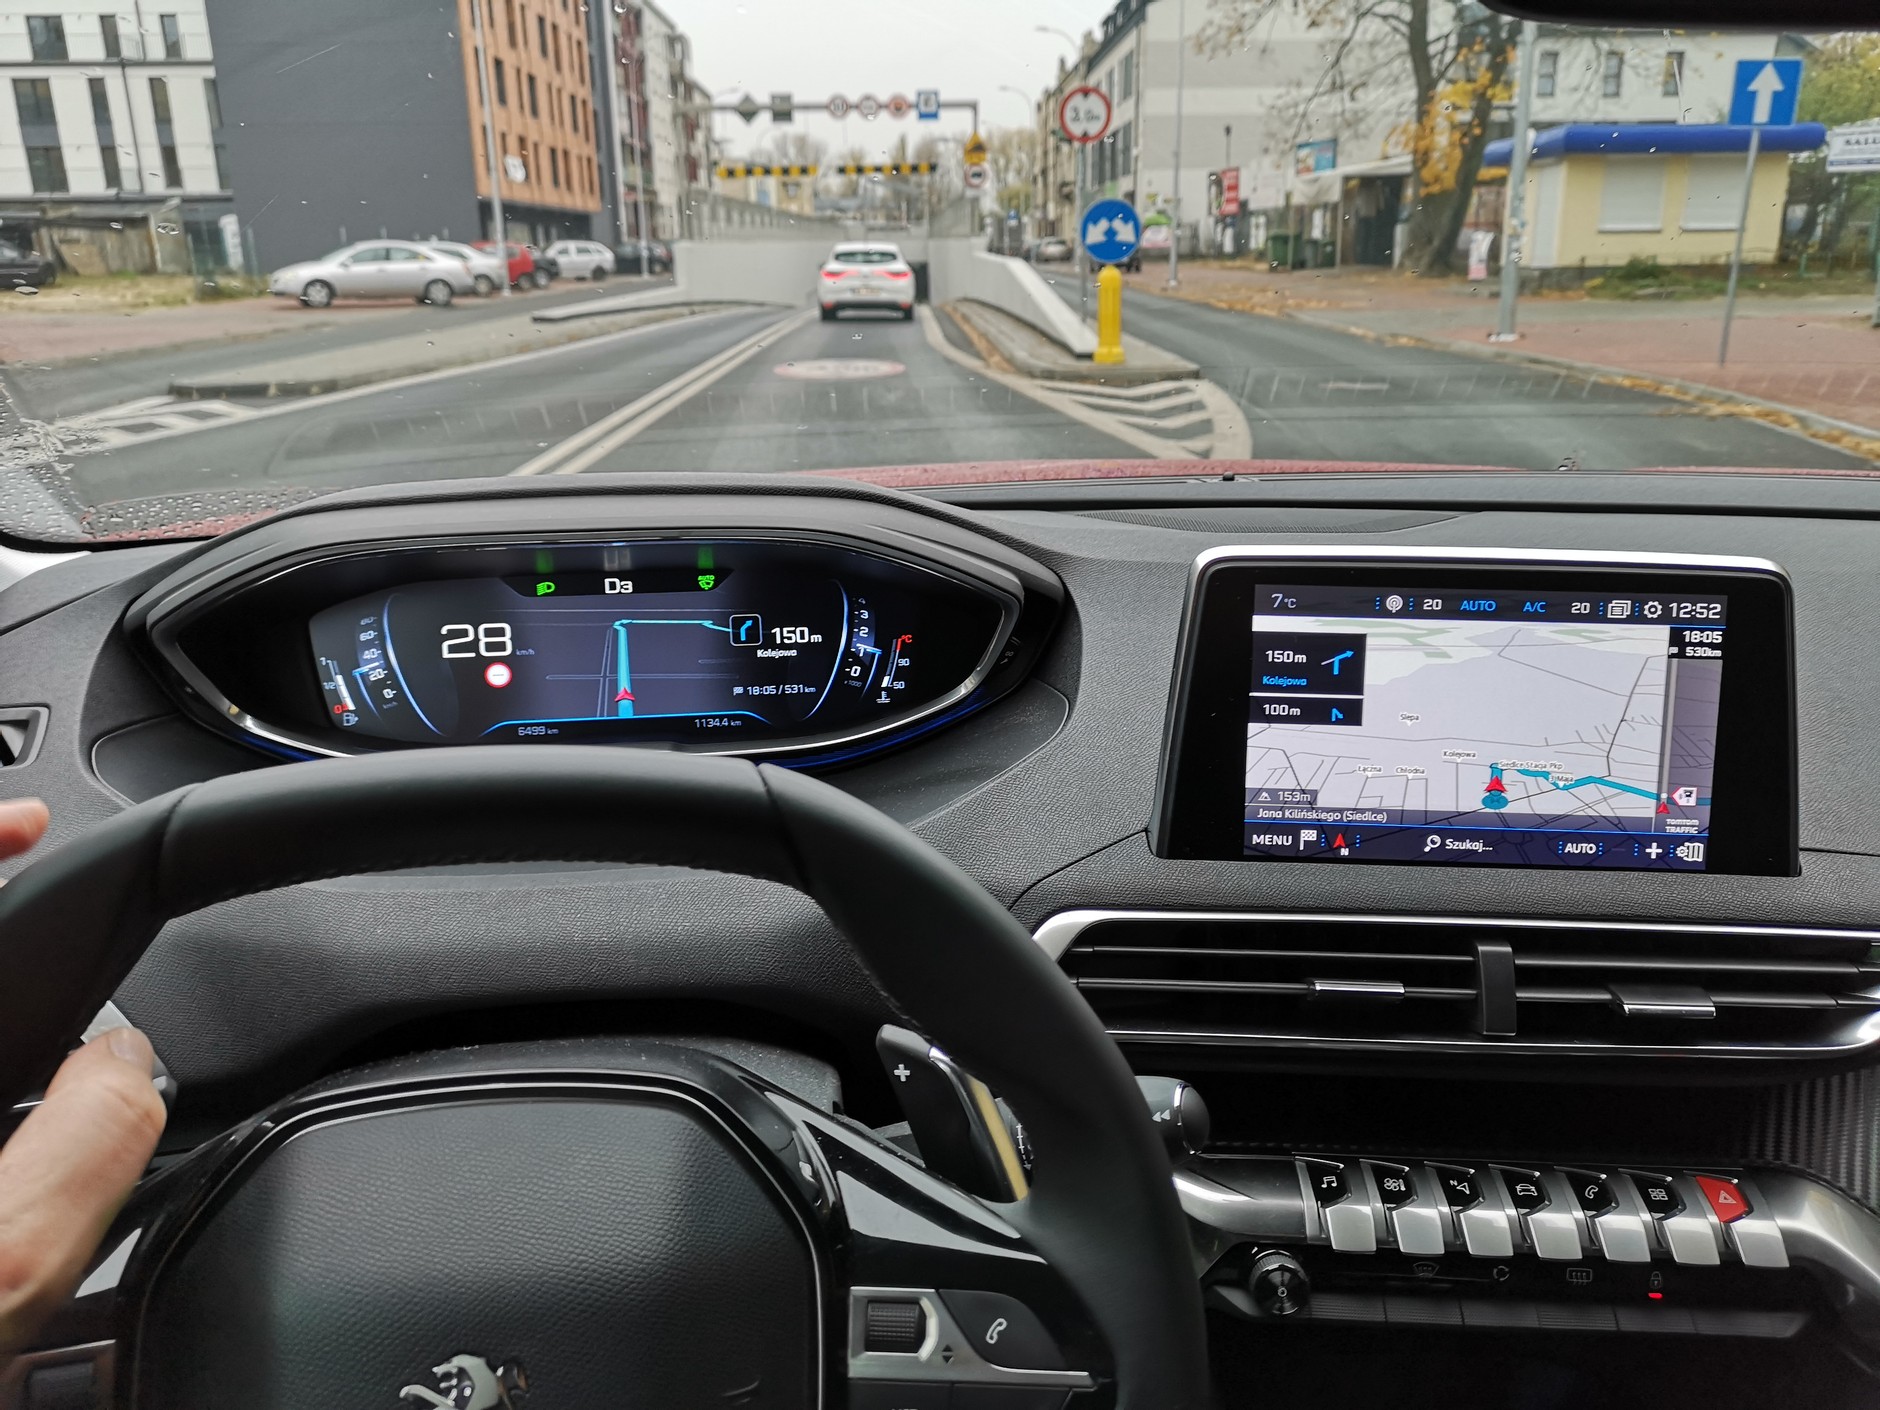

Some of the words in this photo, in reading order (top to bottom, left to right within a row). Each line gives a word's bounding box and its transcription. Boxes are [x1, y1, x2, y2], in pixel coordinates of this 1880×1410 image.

[604, 578, 633, 593] D3
[1423, 599, 1442, 610] 20
[1460, 600, 1496, 611] AUTO
[1523, 602, 1546, 612] A/C
[1571, 602, 1590, 614] 20
[1669, 603, 1721, 619] 12:52
[440, 623, 513, 658] 28
[1683, 631, 1722, 643] 18:05
[757, 649, 797, 658] Kolejowa
[1262, 676, 1307, 687] Kolejowa
[746, 685, 777, 695] 18:05
[694, 718, 729, 728] 1134.4
[518, 726, 546, 736] 6499
[1278, 791, 1311, 801] 153m
[1257, 808, 1283, 819] Jana
[1284, 809, 1341, 822] Kilińskiego
[1343, 810, 1388, 823] (Siedlce)
[1665, 826, 1698, 834] TRAFFIC
[1252, 834, 1293, 846] MENU
[1564, 843, 1597, 854] AUTO
